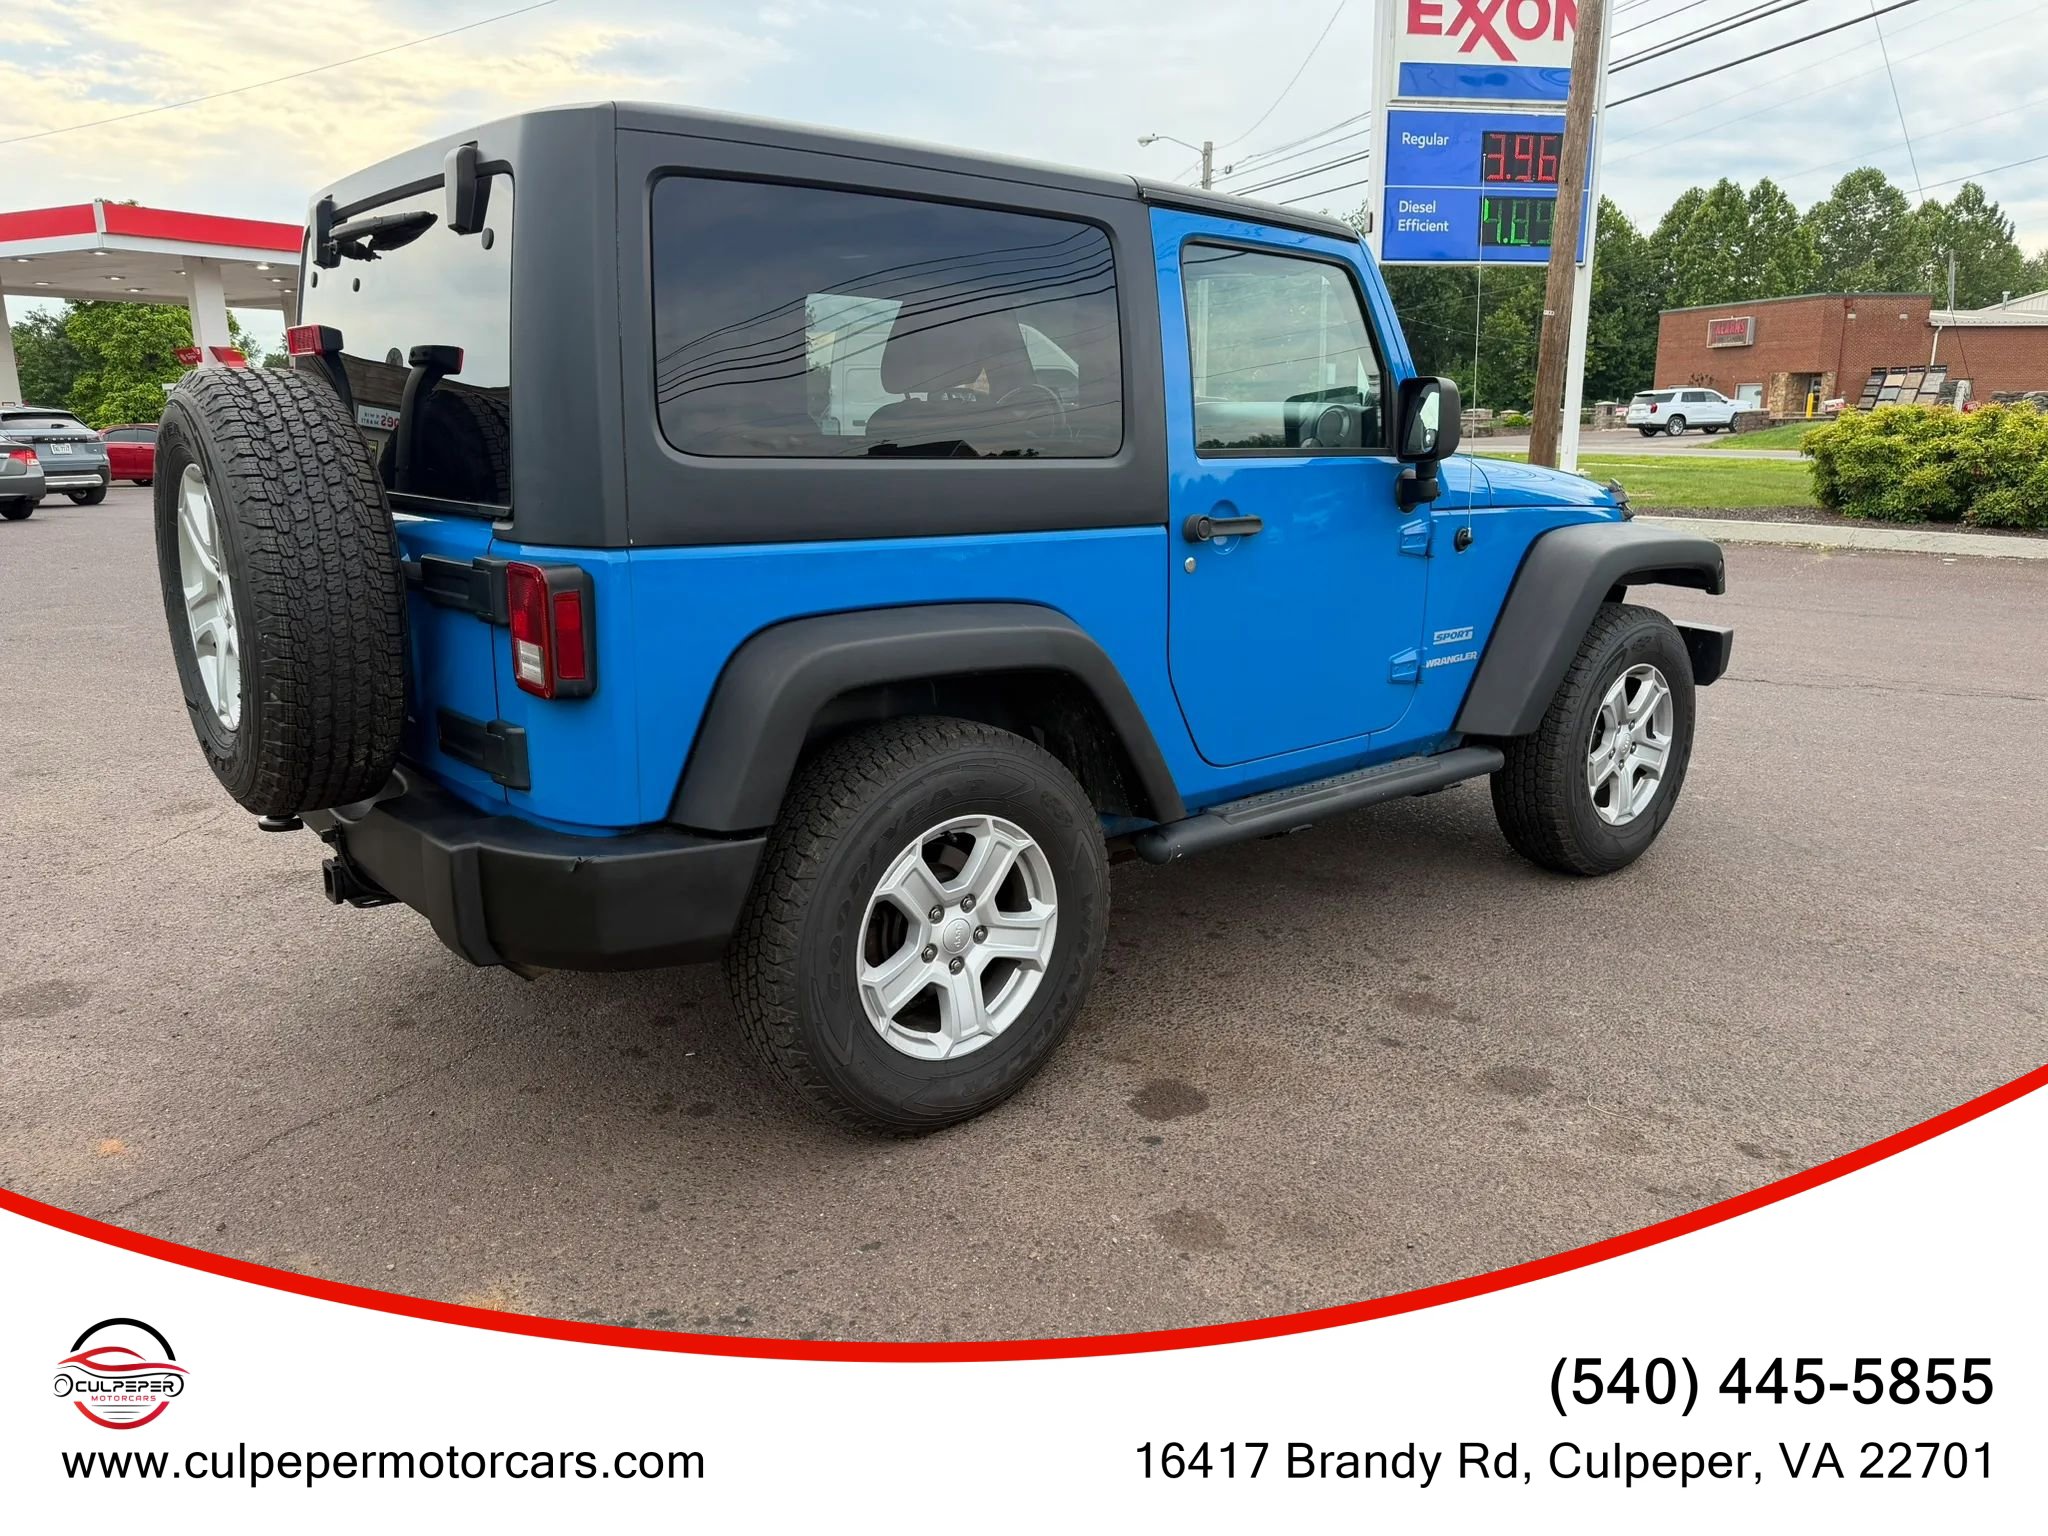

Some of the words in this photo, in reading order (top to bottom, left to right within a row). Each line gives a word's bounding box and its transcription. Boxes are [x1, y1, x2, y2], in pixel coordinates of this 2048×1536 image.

[1401, 132, 1449, 149] Regular
[1486, 133, 1557, 181] 3.96
[1399, 200, 1436, 213] Diesel
[1398, 218, 1449, 232] Efficient
[1435, 629, 1470, 642] SPORT
[1426, 651, 1478, 668] WRANGLER
